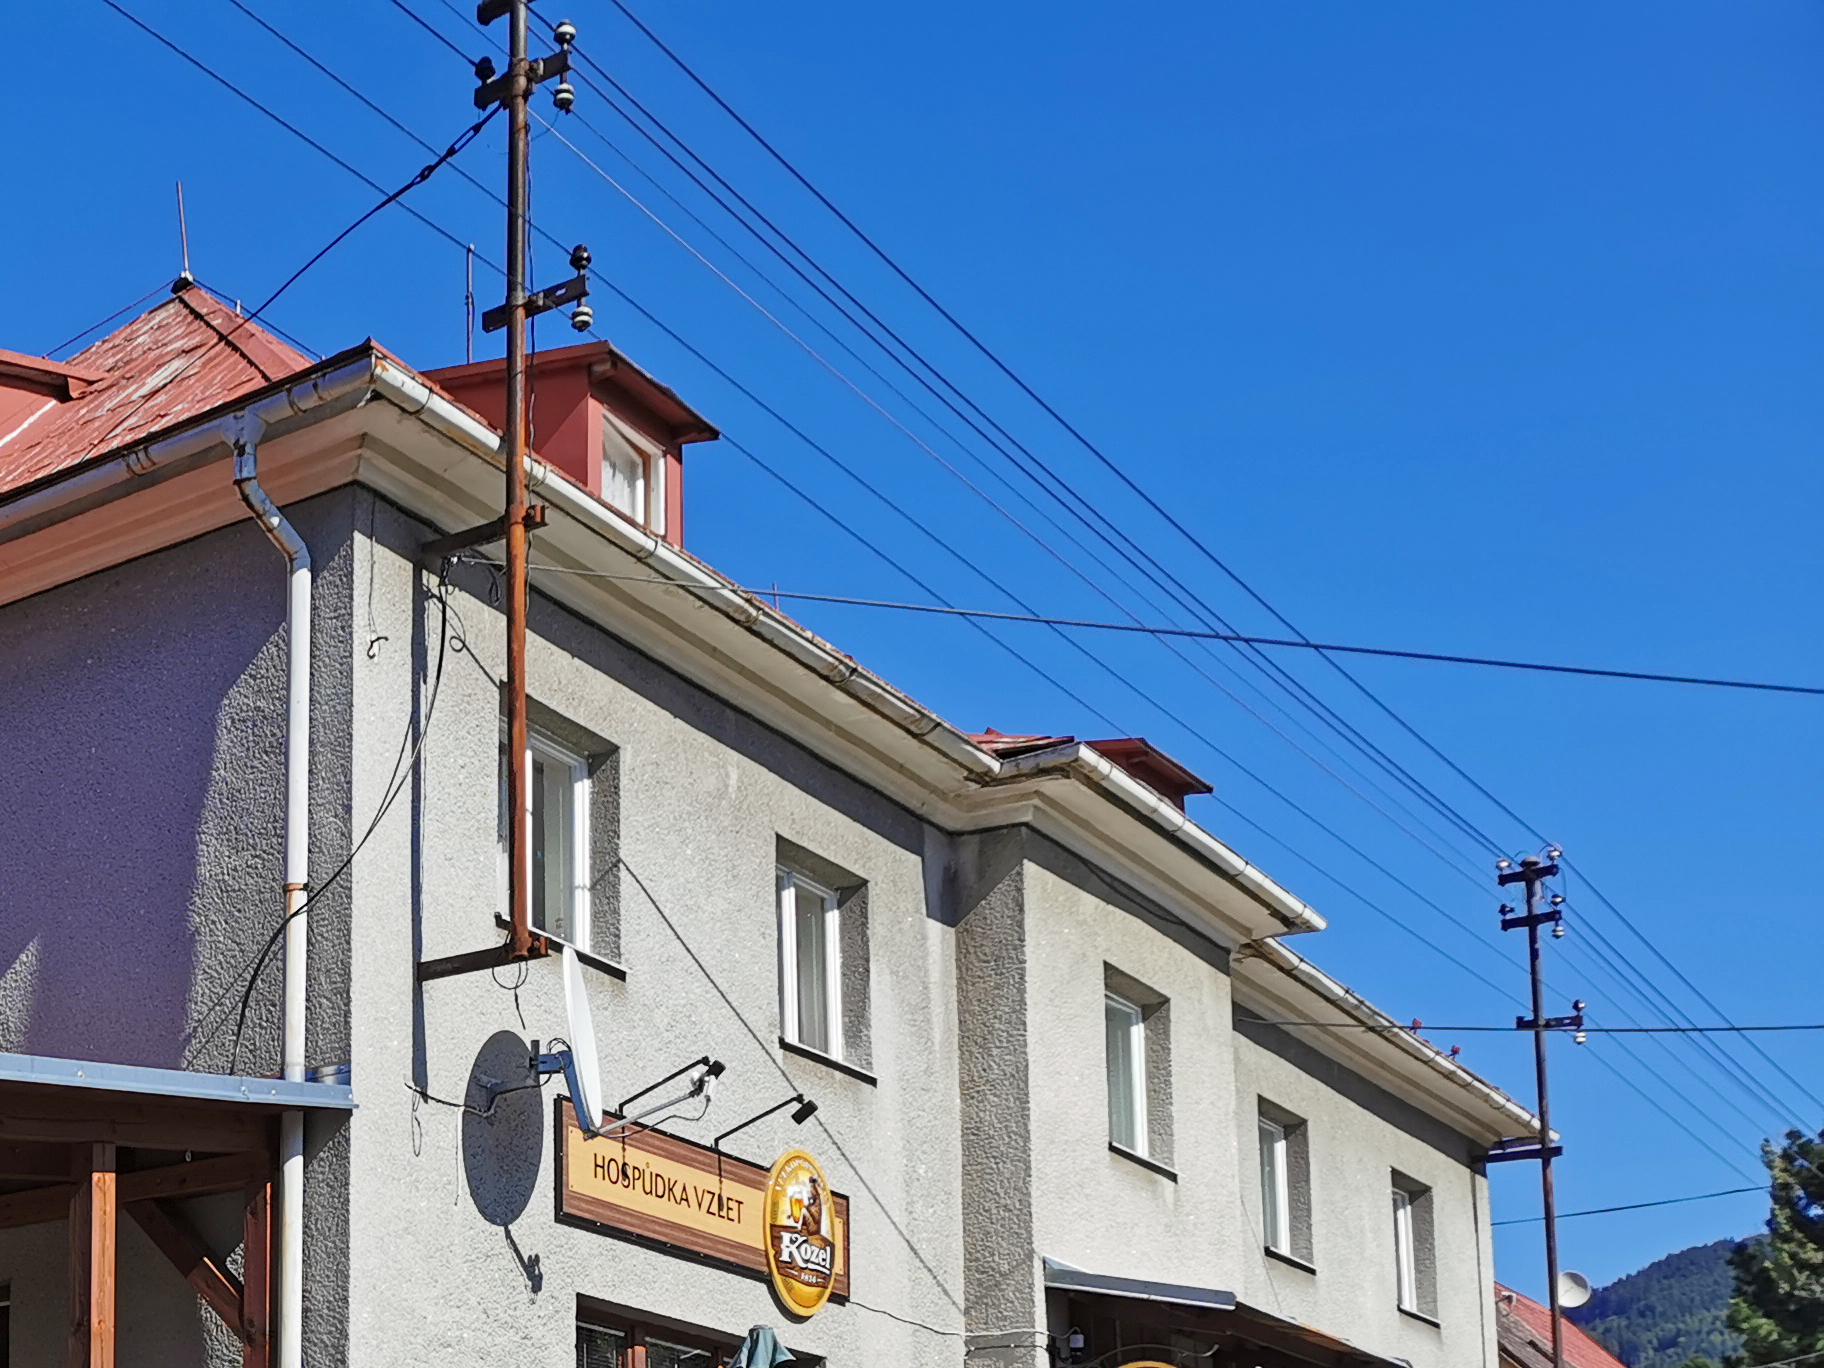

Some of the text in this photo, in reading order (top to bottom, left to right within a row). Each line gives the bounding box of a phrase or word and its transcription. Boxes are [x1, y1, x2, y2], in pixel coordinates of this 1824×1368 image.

[593, 1152, 744, 1225] HOSPŮDKA VZLET
[778, 1231, 831, 1275] Kozel
